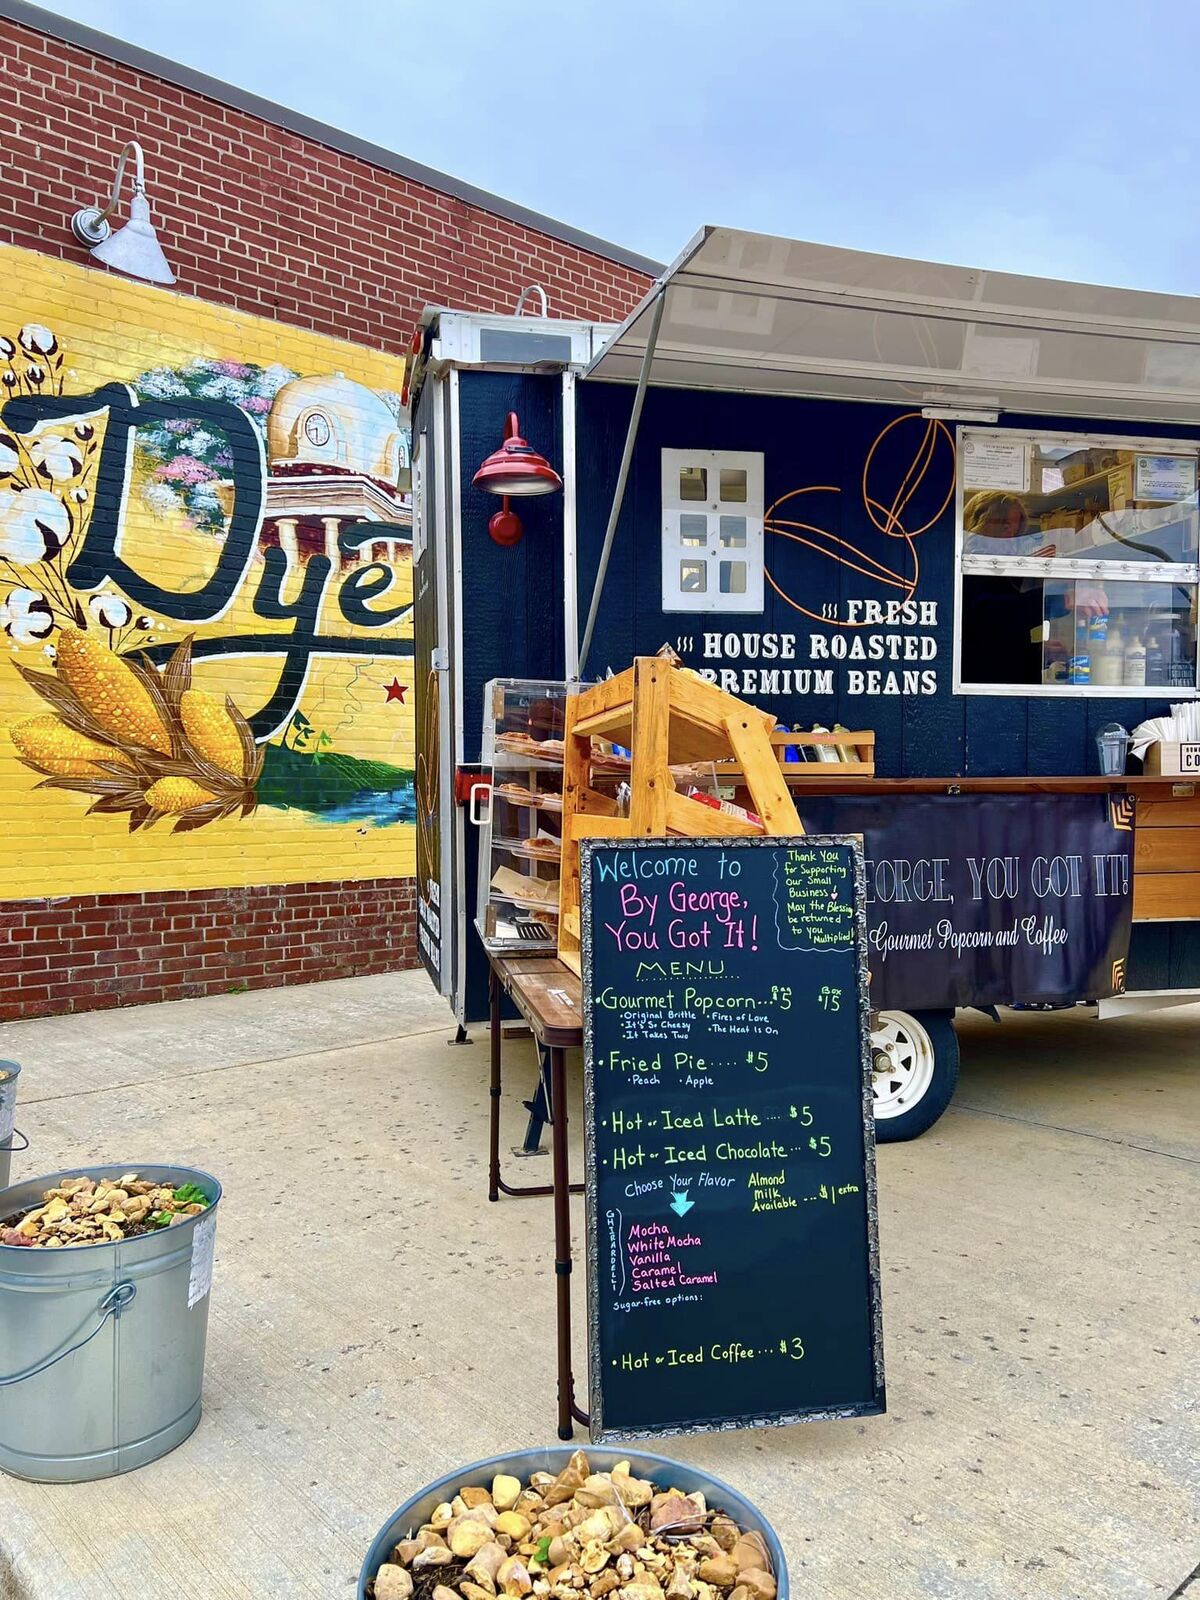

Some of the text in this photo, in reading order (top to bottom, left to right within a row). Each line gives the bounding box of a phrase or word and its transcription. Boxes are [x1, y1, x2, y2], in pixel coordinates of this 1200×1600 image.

[846, 599, 938, 626] FRESH
[703, 632, 938, 660] HOUSE ROASTED
[699, 668, 937, 695] PREMIUM BEANS
[595, 851, 742, 882] Welcome to
[787, 850, 839, 863] Thank You
[784, 861, 846, 878] for Supporting
[966, 857, 1020, 900] YOU
[1031, 855, 1082, 897] GOT
[1092, 854, 1129, 896] IT!
[807, 876, 832, 885] Small
[619, 881, 749, 926] By George,
[786, 902, 806, 914] May
[809, 899, 825, 911] the
[787, 913, 842, 924] be returned
[605, 914, 759, 952] You Got It!
[791, 925, 803, 935] to
[869, 914, 1069, 962] Gourmet Popcorn and Coffee
[636, 959, 726, 978] MENU
[601, 986, 675, 1010] Gourmet
[624, 1010, 770, 1024] Original Brittle Fires of Love
[624, 1020, 644, 1030] It's
[648, 1021, 658, 1029] So
[660, 1020, 691, 1032] Cheesy
[712, 1023, 727, 1034] The
[729, 1024, 749, 1034] Heat
[765, 1026, 779, 1036] On
[626, 1030, 689, 1040] It Takes Two
[609, 1051, 769, 1072] Fried Pie $5
[632, 1074, 714, 1086] Peach Apple
[612, 1110, 643, 1135] Hot
[661, 1108, 704, 1130] Iced
[713, 1107, 762, 1127] Latte
[789, 1105, 814, 1127] $5
[613, 1144, 646, 1170] Hot
[664, 1143, 707, 1165] Iced
[715, 1139, 789, 1161] Chocolate
[808, 1135, 832, 1157] $5
[624, 1171, 736, 1198] Choose Your Flavor
[747, 1169, 786, 1188] Almond
[751, 1196, 798, 1213] Available
[838, 1183, 860, 1195] extra
[628, 1222, 670, 1241] Mocha
[666, 1233, 702, 1249] Mocha
[606, 1209, 617, 1292] GHIRARDELLI
[629, 1251, 671, 1267] Vanilla
[631, 1261, 682, 1279] Caramel
[631, 1271, 718, 1292] Salted Caramel
[621, 1352, 649, 1371] Hot
[667, 1346, 704, 1366] Iced
[710, 1343, 755, 1363] Coffee
[779, 1337, 805, 1360] $3
